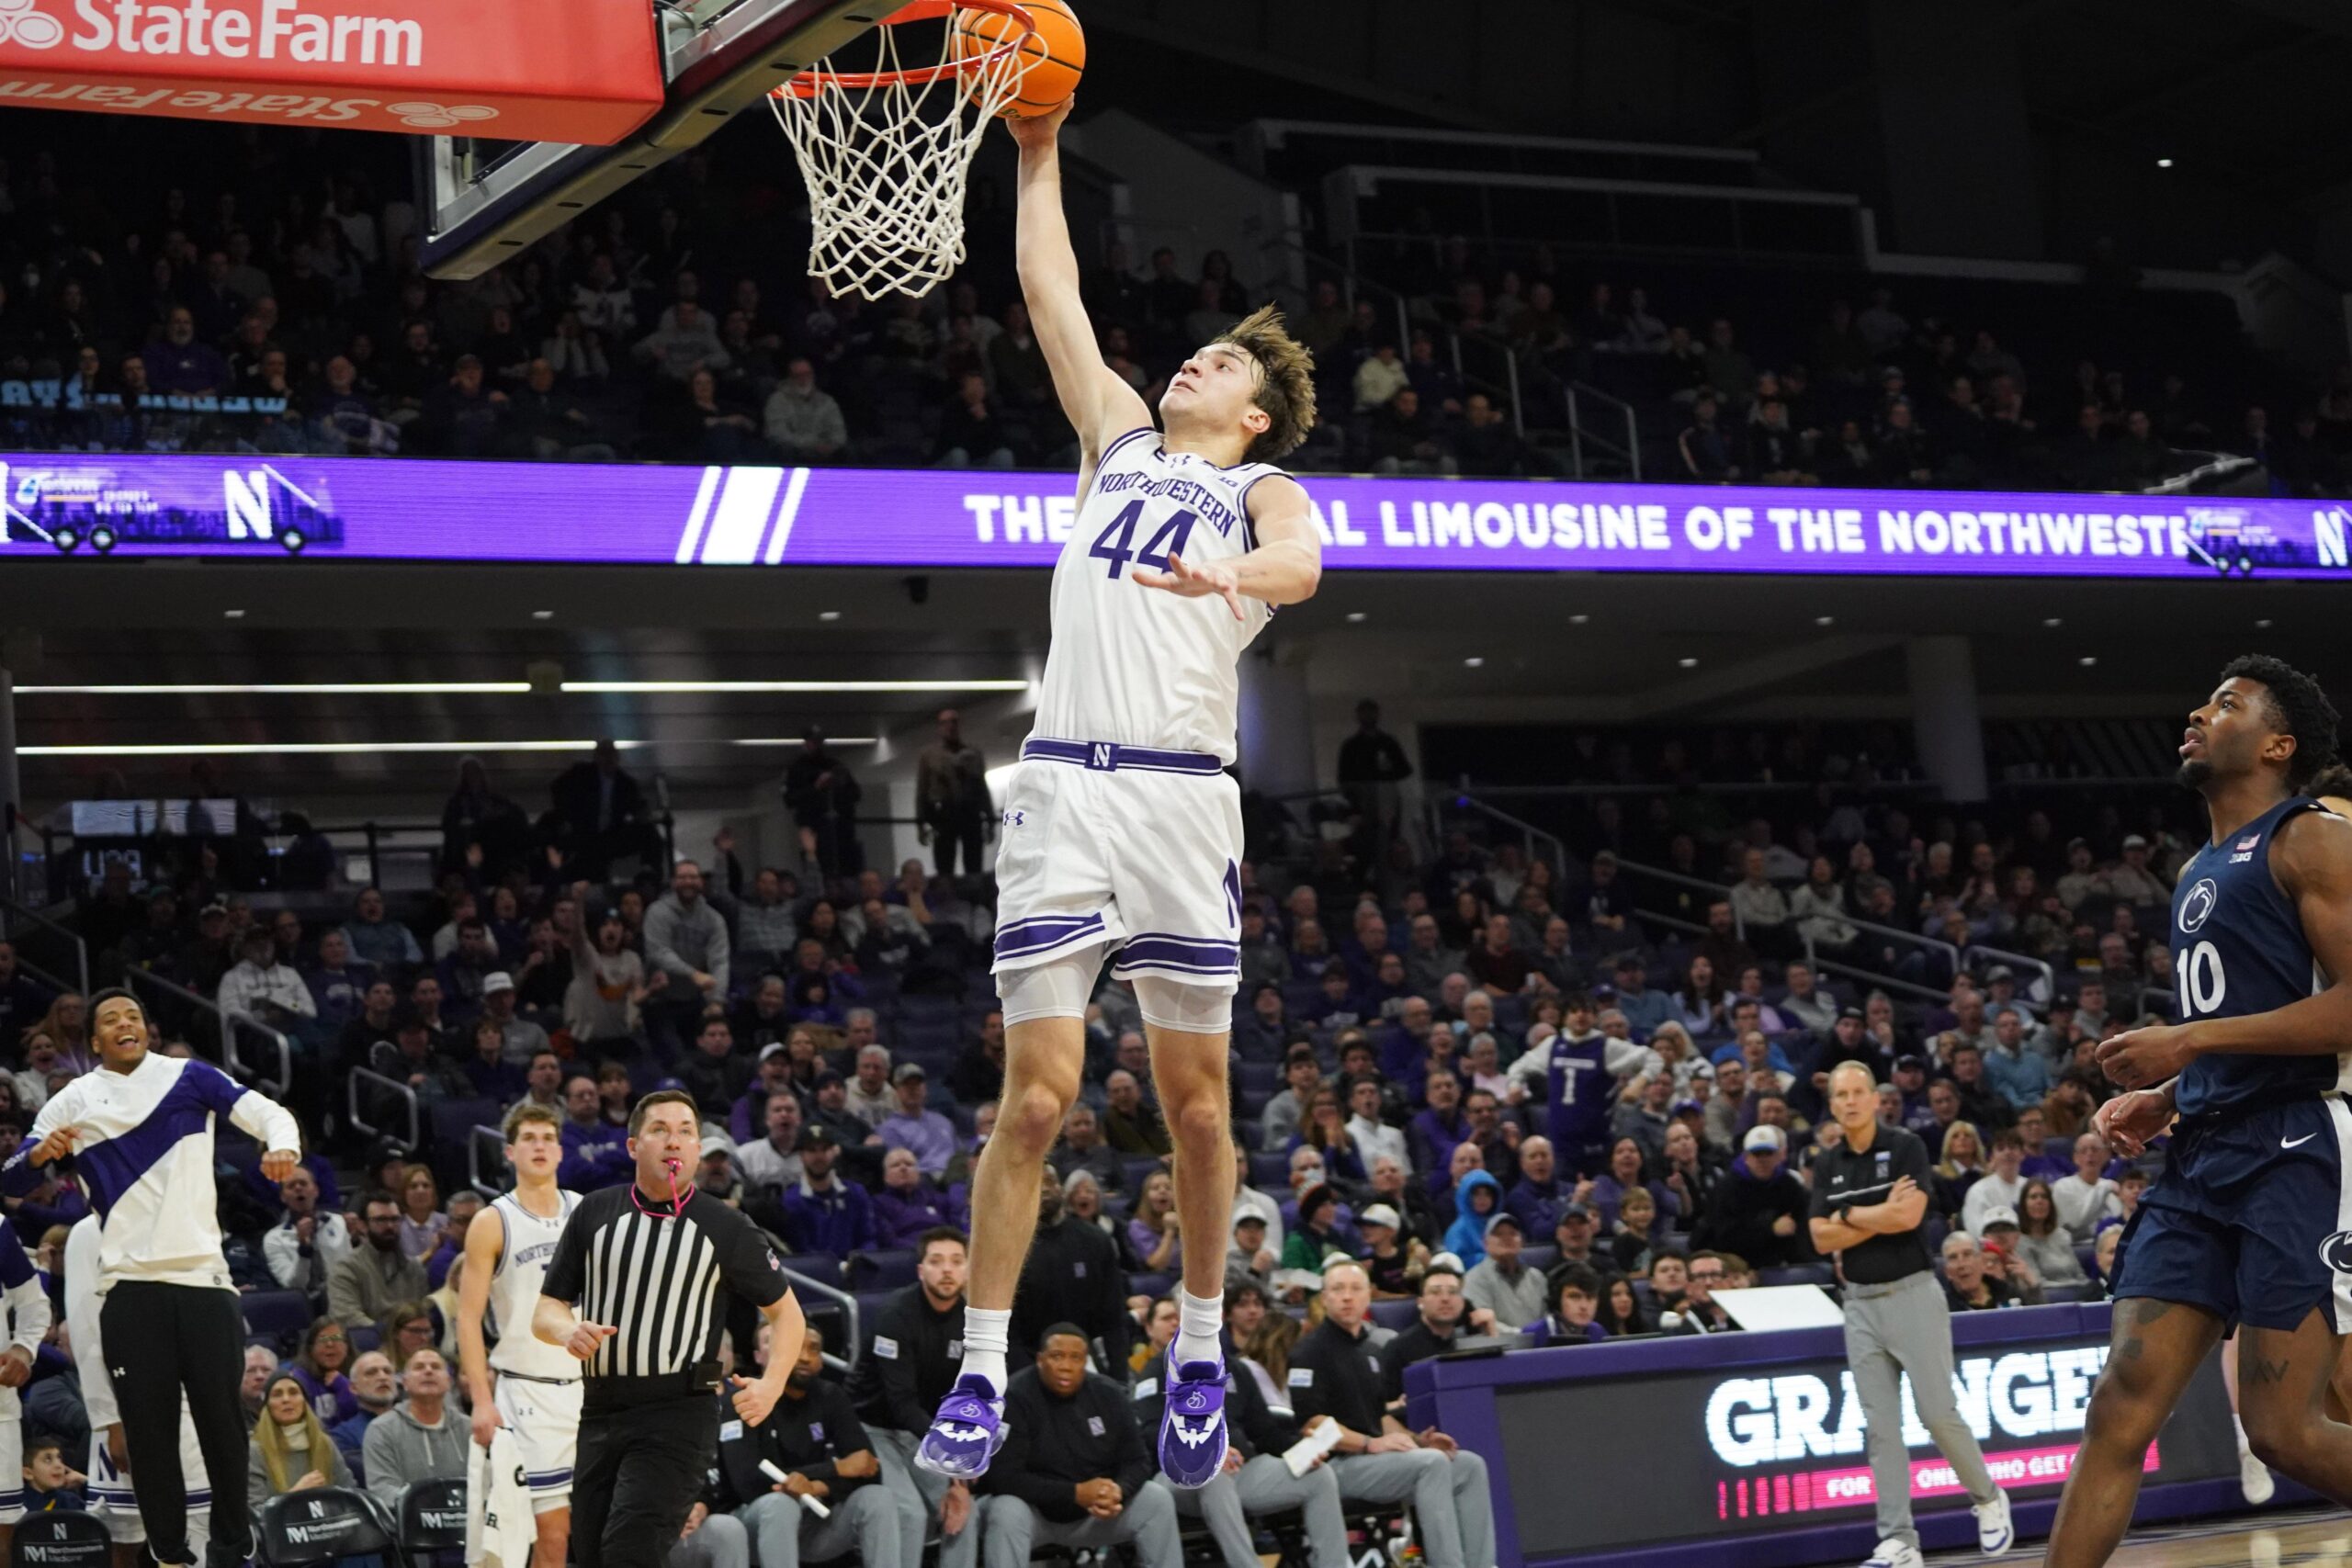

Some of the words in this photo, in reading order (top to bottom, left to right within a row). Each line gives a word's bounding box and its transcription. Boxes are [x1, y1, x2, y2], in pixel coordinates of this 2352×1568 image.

[964, 493, 1075, 543] THE
[1380, 500, 1672, 550] LIMOUSINE
[1684, 505, 1754, 552] OF
[1767, 507, 1867, 554] THE
[1088, 499, 1199, 580] 44
[1099, 470, 1237, 539] NORTHWESTERN
[2177, 940, 2226, 1019] 10
[1706, 1346, 2111, 1467] GRAINGE
[1826, 1475, 1871, 1498] FOR
[1917, 1465, 1960, 1489] ONE
[2029, 1454, 2066, 1476] GET
